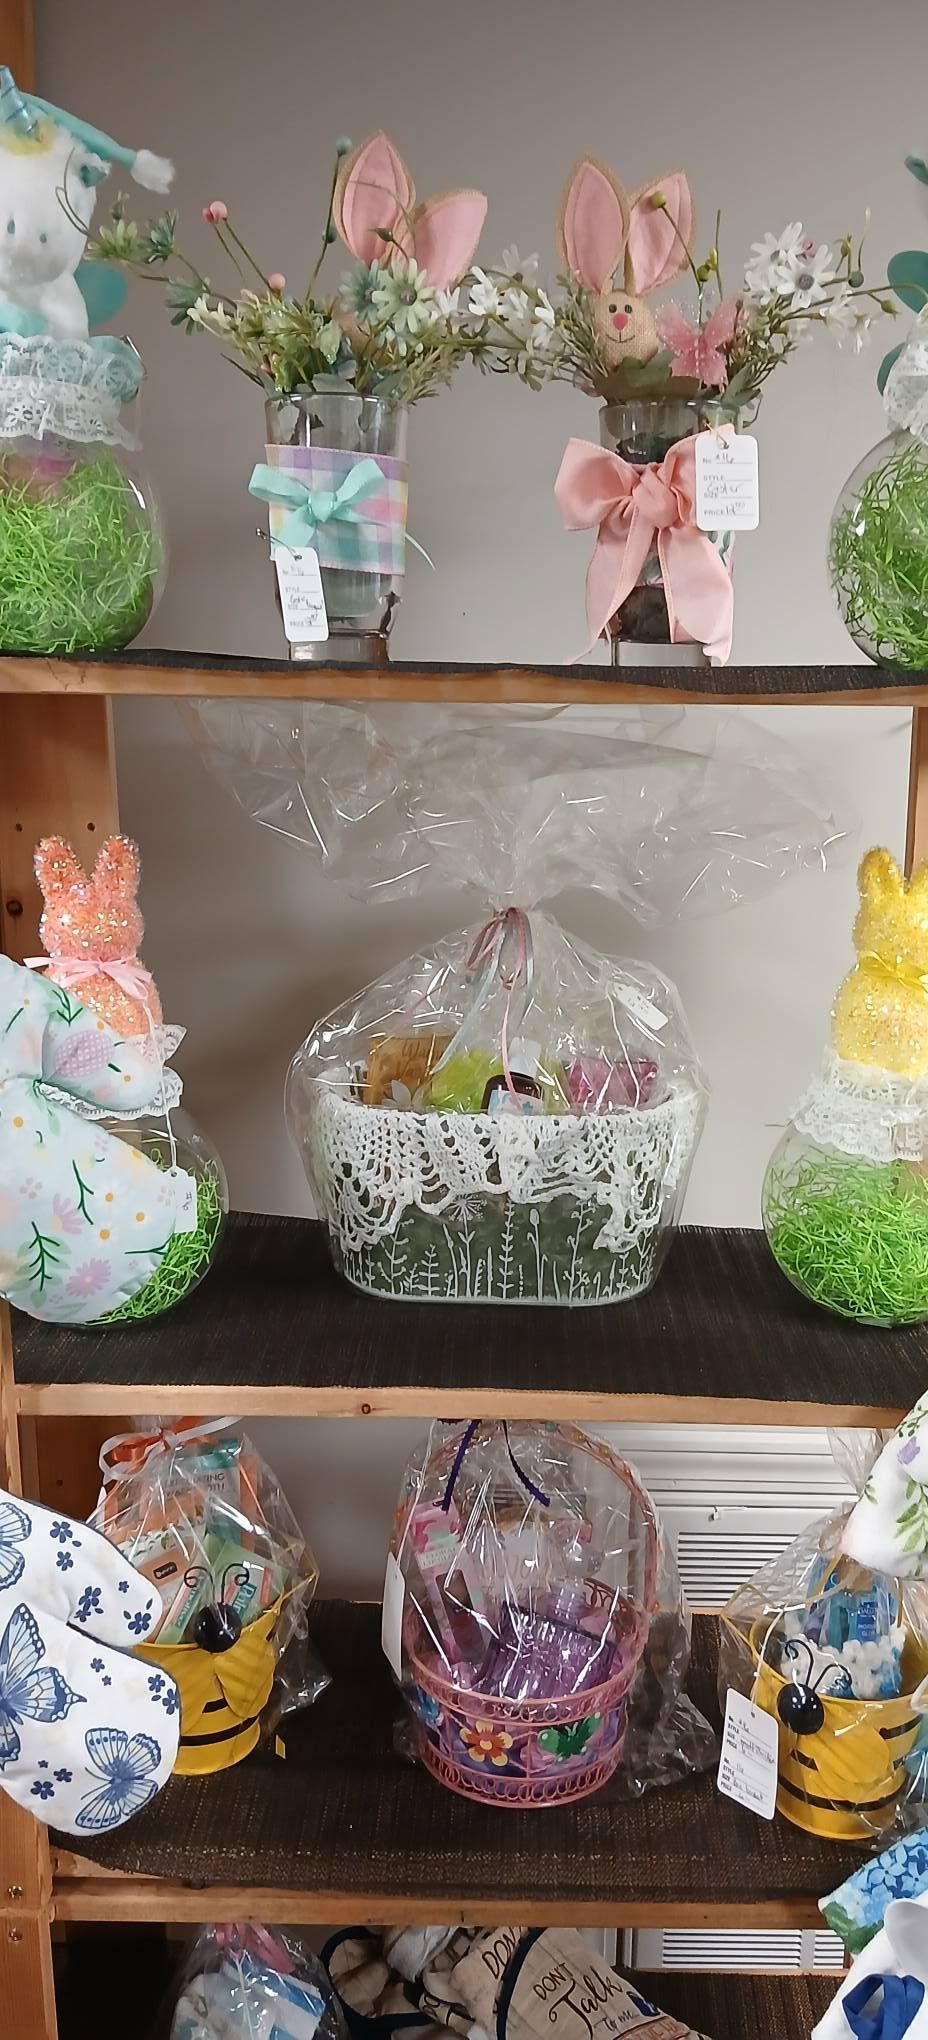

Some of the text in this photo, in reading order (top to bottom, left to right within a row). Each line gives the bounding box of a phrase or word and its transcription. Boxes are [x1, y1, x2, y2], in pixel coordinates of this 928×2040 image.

[703, 509, 724, 517] PRICE
[533, 1962, 574, 2000] DON'T
[549, 1965, 623, 2040] Talk
